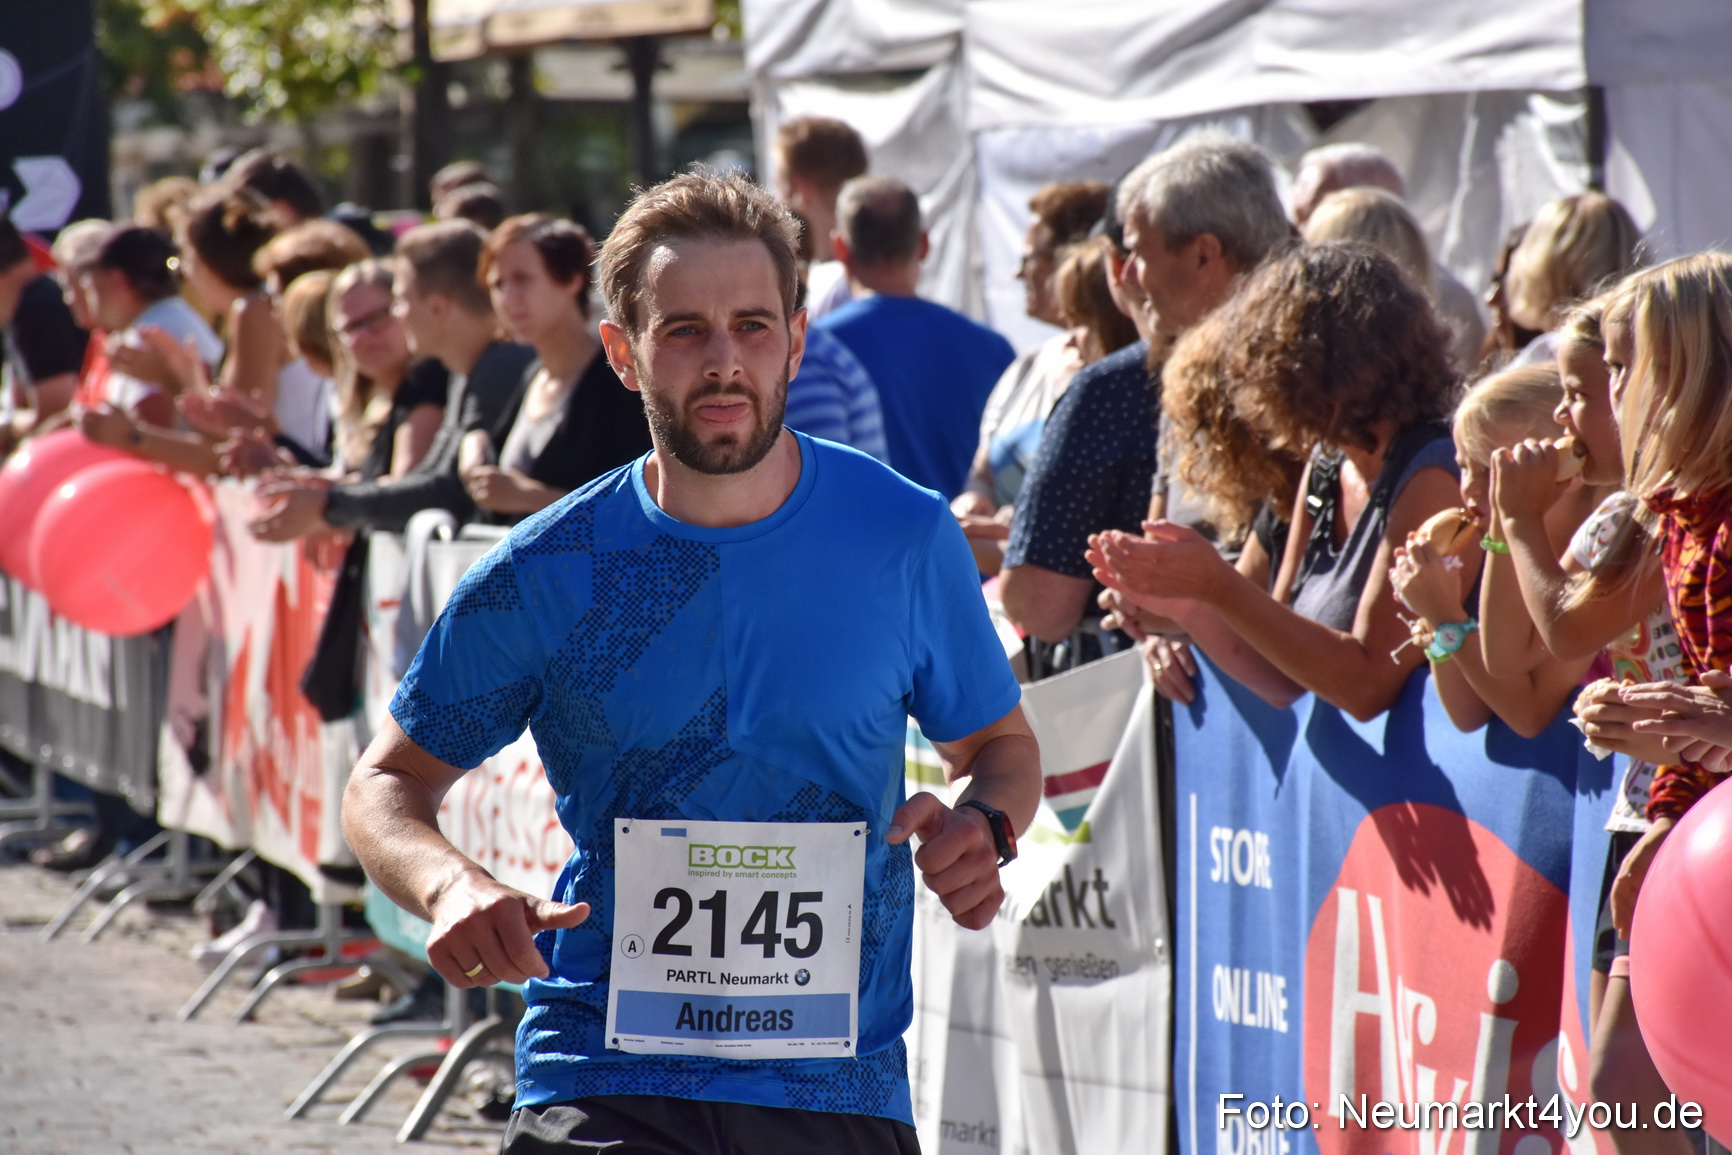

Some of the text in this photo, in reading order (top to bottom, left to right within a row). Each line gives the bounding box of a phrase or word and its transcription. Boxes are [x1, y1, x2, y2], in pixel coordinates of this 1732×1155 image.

[688, 843, 797, 869] BOCK
[1210, 826, 1273, 889] STORE
[687, 868, 797, 879] inspired by smart concepts
[1020, 864, 1116, 929] arkt
[652, 887, 823, 958] 2145
[628, 940, 637, 953] A
[666, 969, 716, 984] PARTL
[720, 972, 789, 985] Neumarkt
[1212, 963, 1288, 1033] ONLINE
[675, 1002, 794, 1033] Andreas
